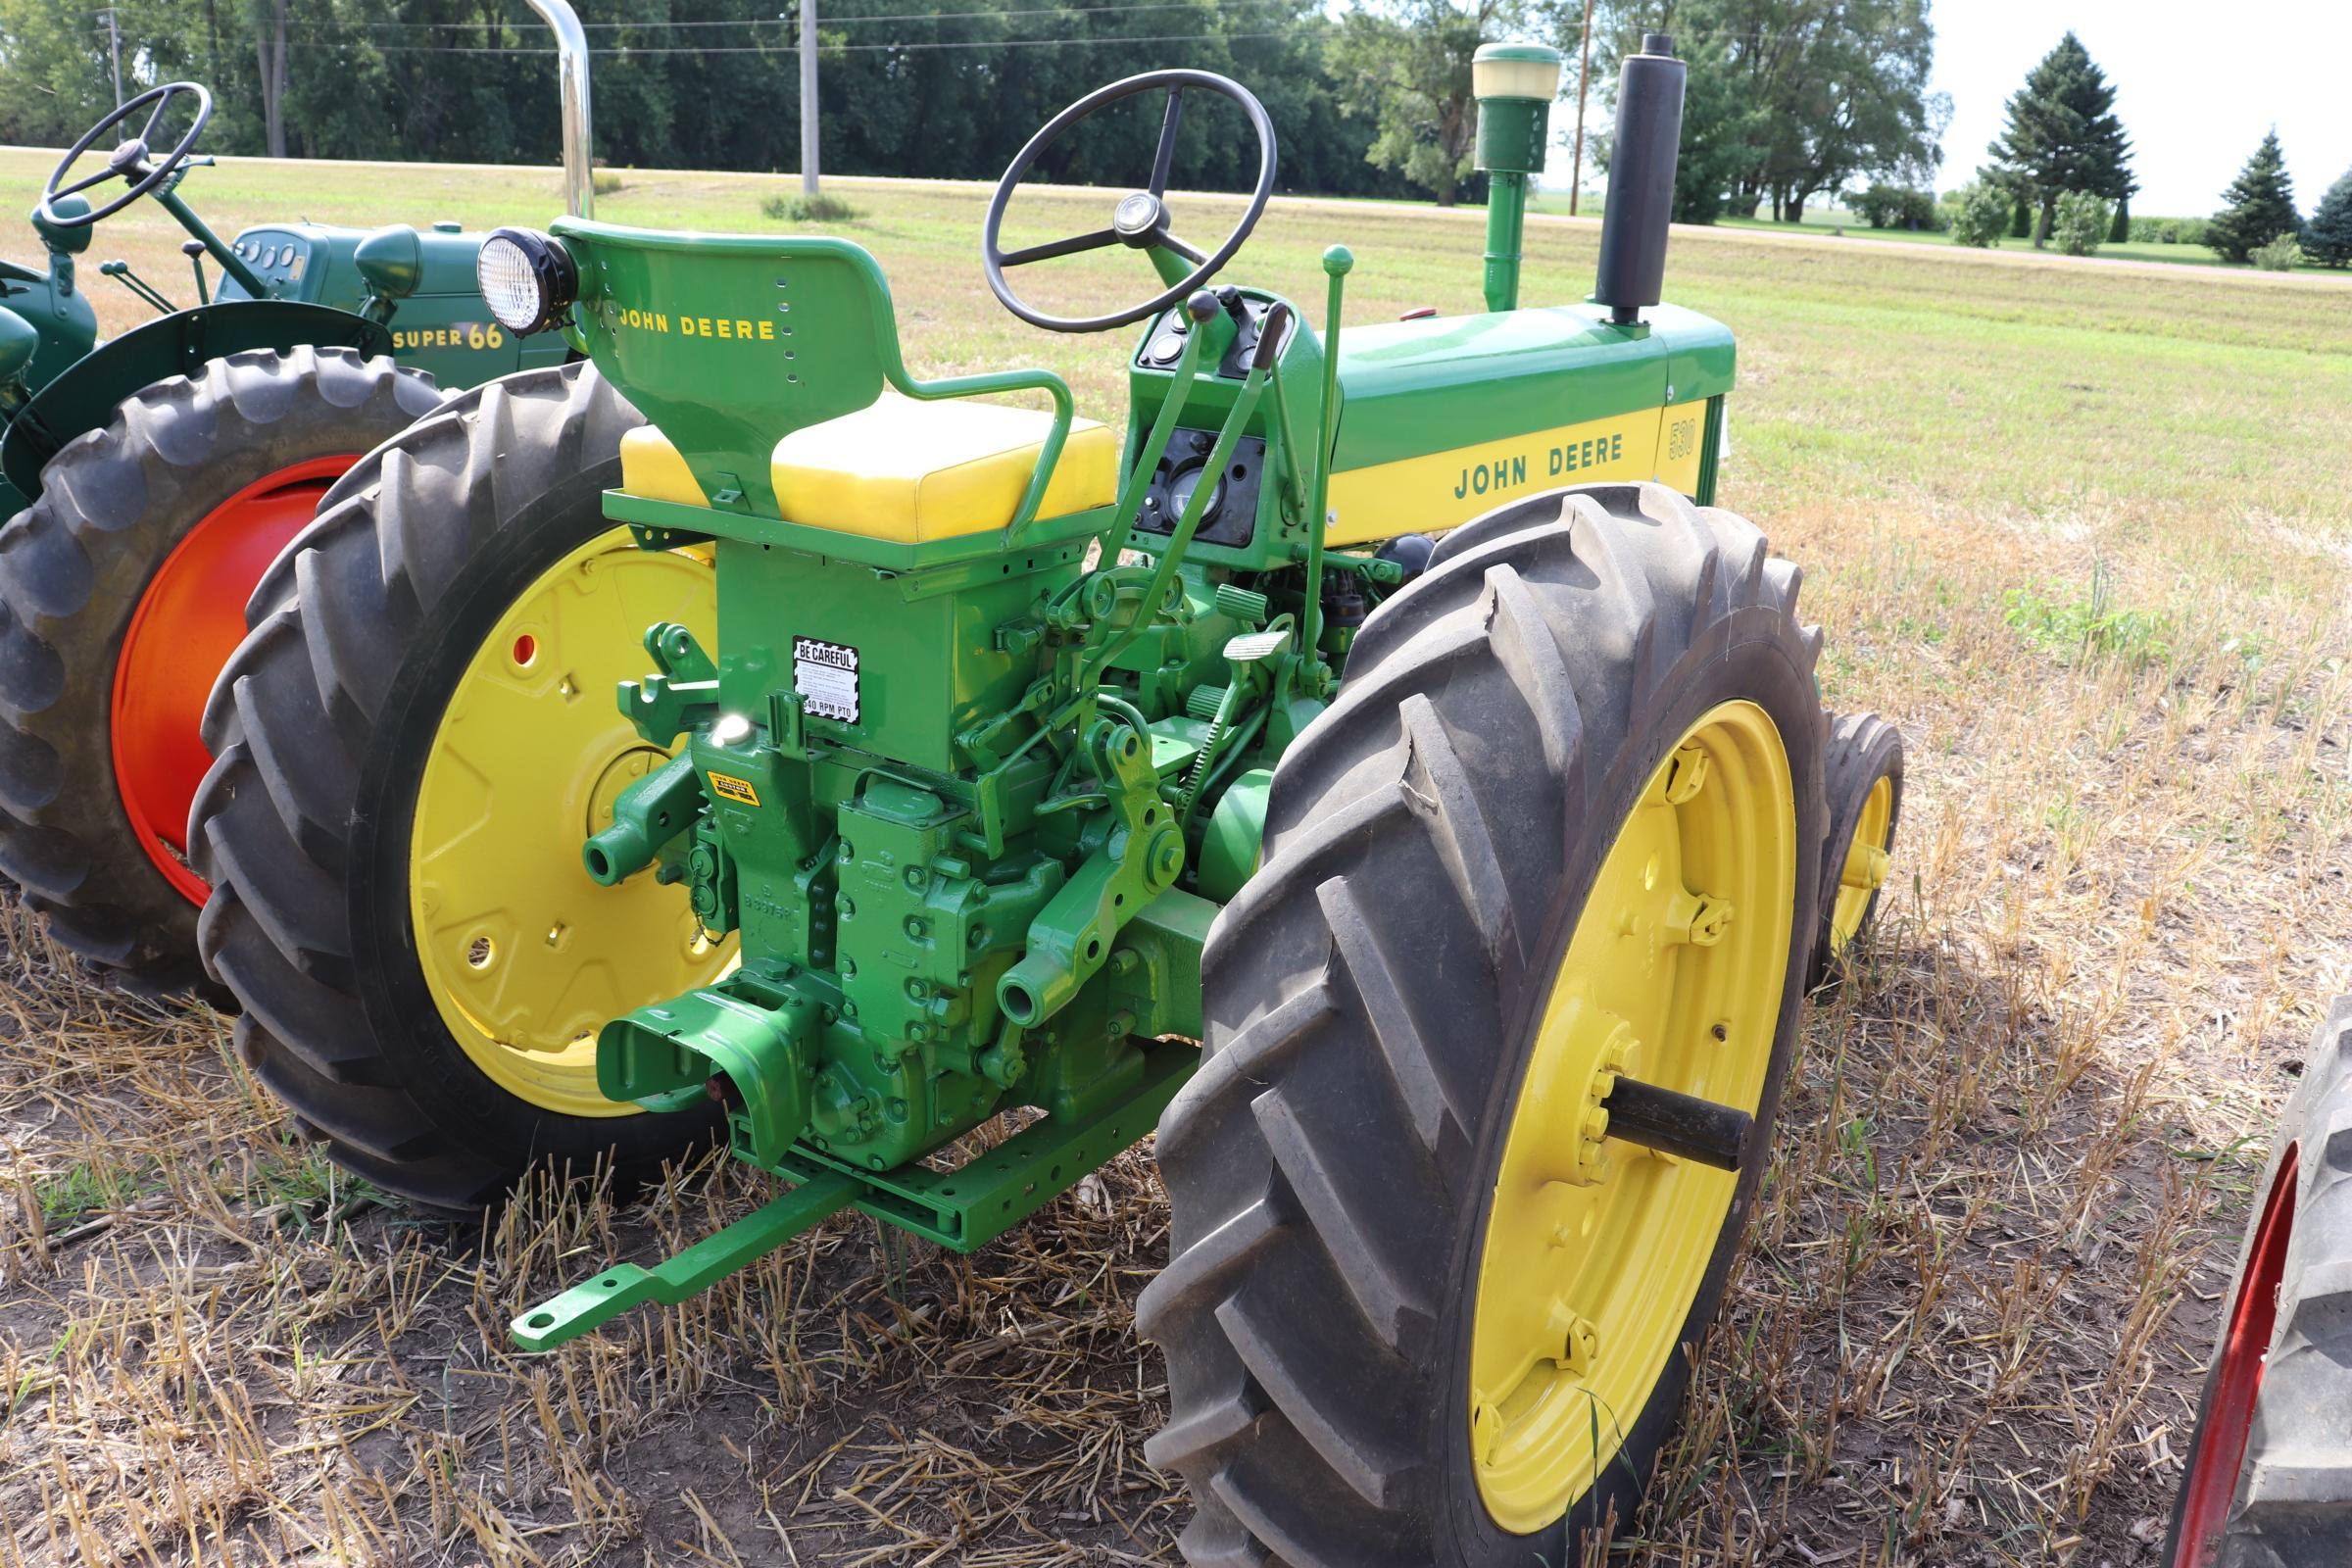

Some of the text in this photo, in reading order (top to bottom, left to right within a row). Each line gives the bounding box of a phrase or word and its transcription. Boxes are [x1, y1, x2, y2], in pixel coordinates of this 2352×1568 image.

[392, 322, 502, 349] SUPER 66
[619, 309, 774, 339] JOHN DEERE
[1669, 418, 1695, 461] 530
[1454, 434, 1622, 500] JOHN DEERE
[800, 644, 852, 667] BE CAREFUL
[819, 702, 835, 712] RPM
[838, 706, 851, 716] PTO
